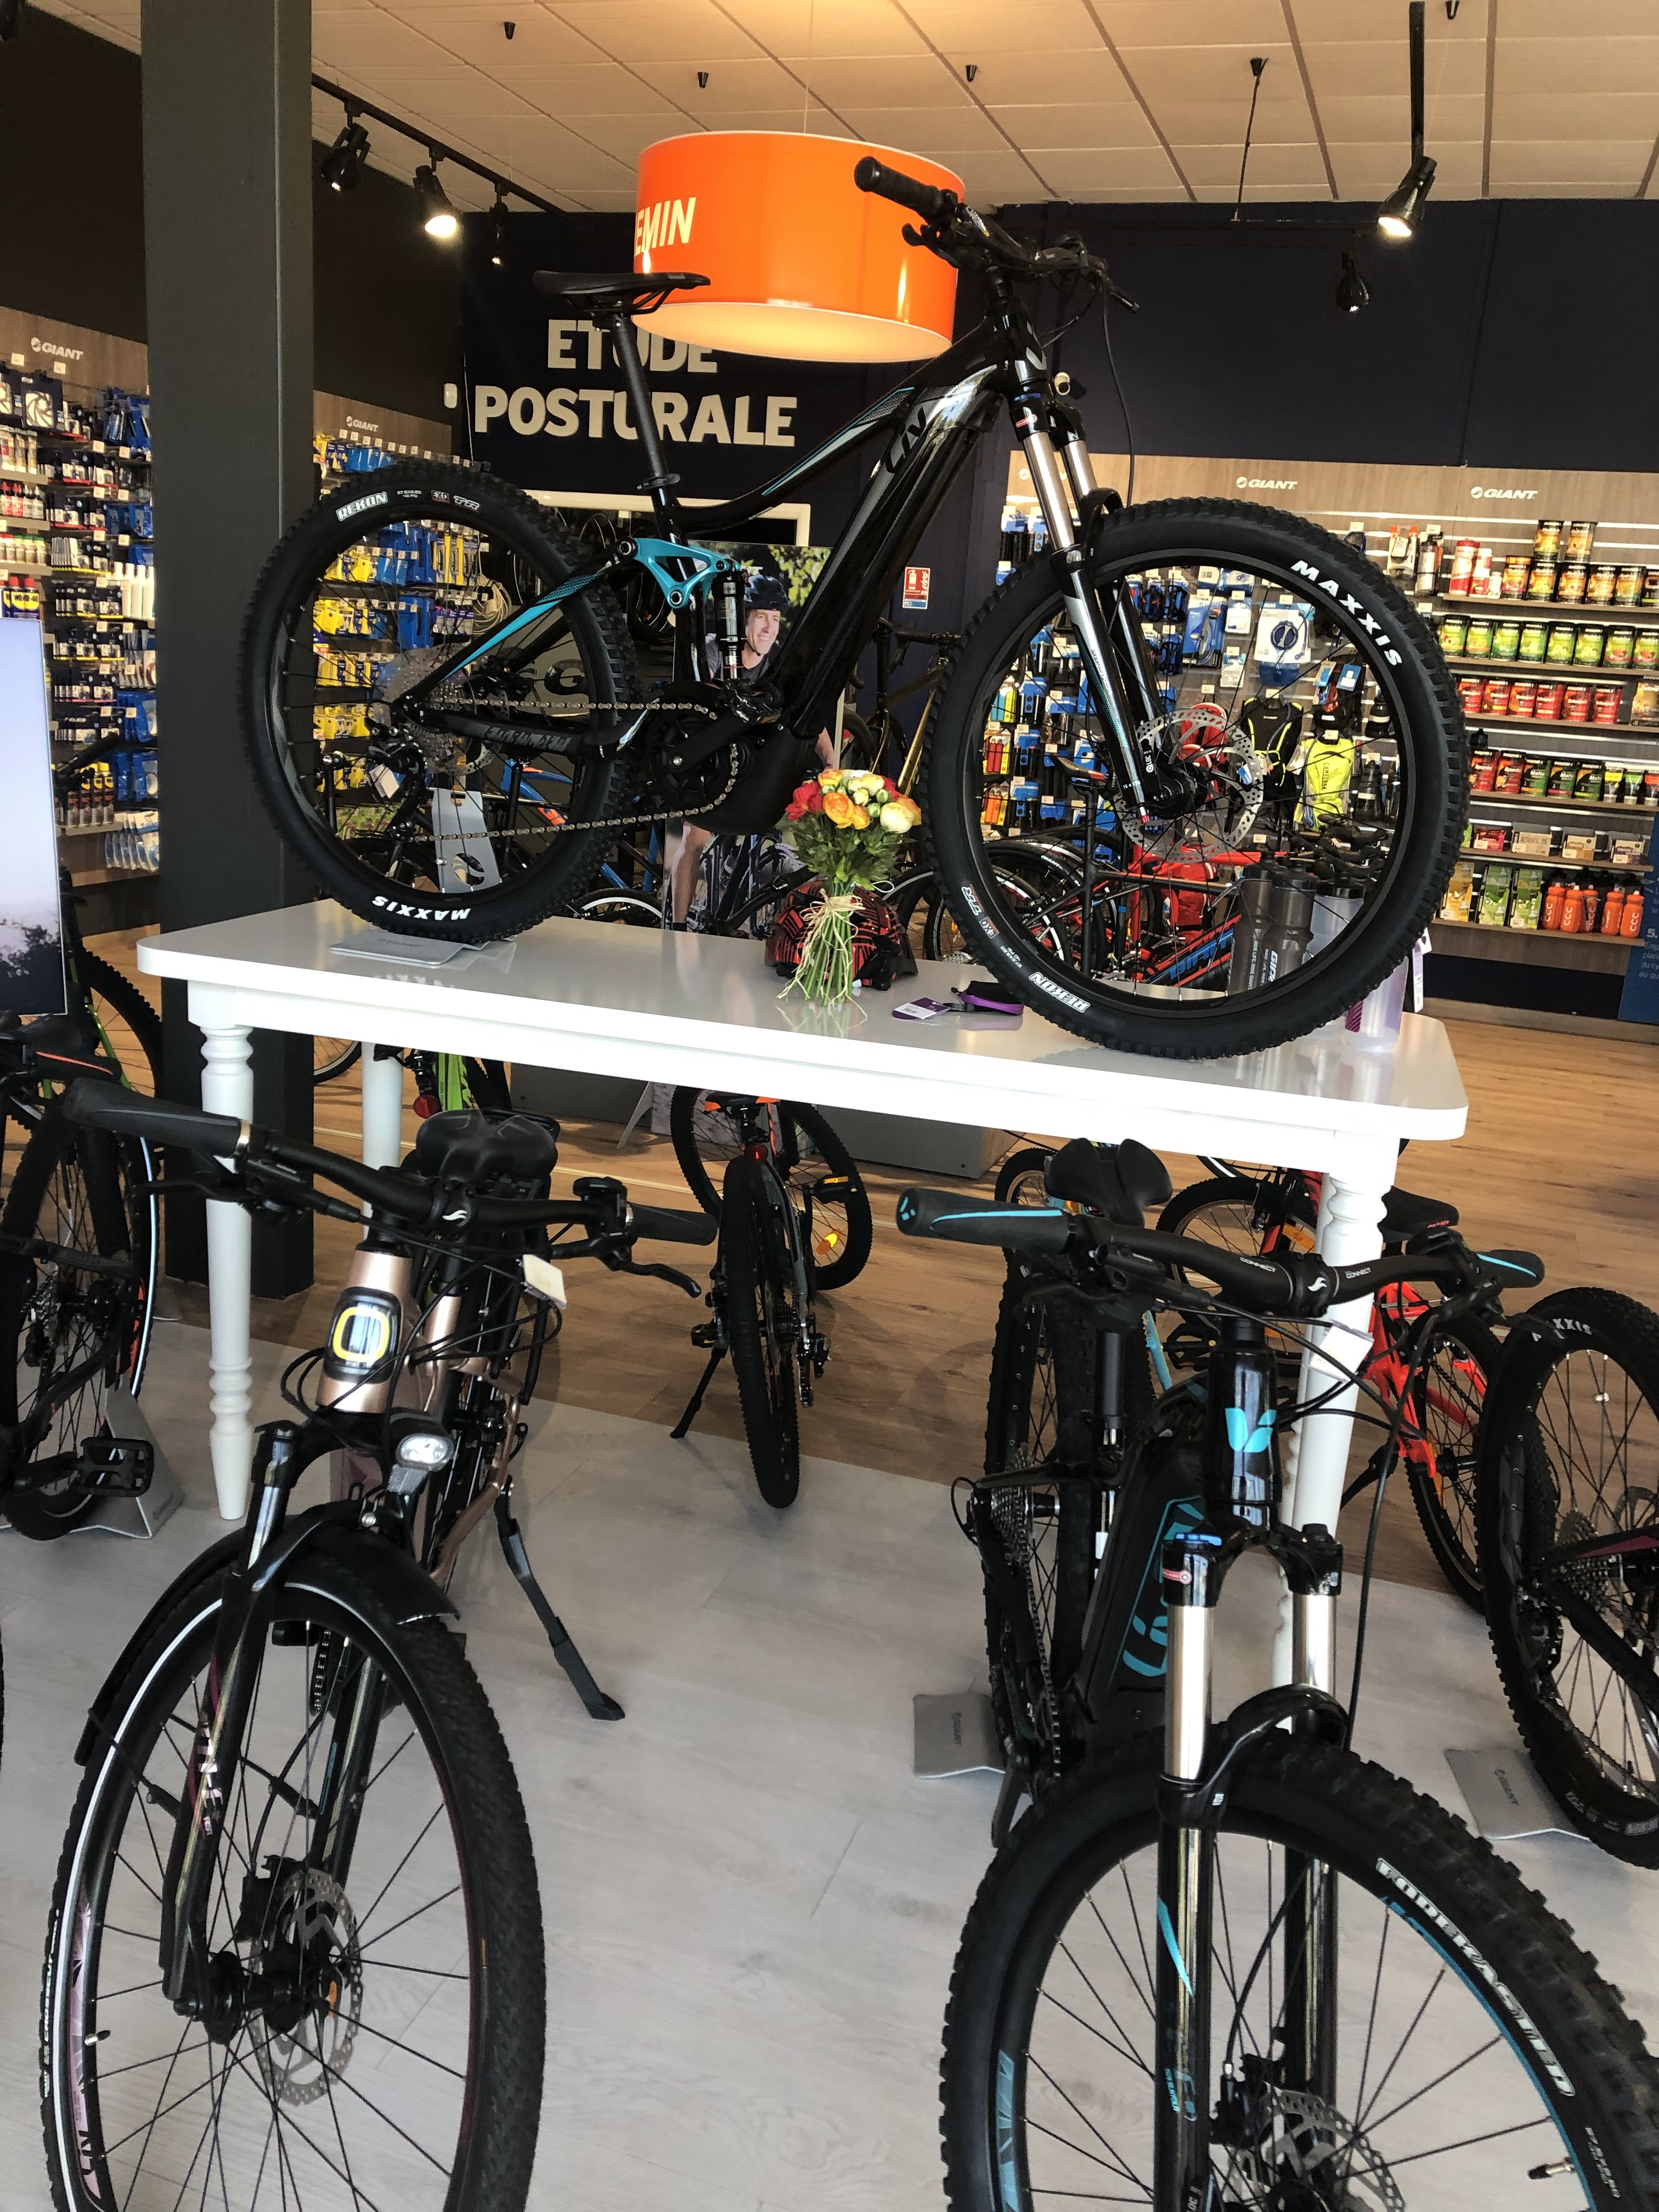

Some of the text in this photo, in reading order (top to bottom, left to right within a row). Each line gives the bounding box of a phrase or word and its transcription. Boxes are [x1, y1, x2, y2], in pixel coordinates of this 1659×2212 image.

[42, 341, 83, 360] GIANT
[352, 418, 379, 432] GIANT
[475, 385, 797, 447] POSTURALE
[1248, 479, 1298, 490] GIANT
[1483, 488, 1538, 500] GIANT
[335, 491, 388, 522] REKON
[1291, 560, 1402, 667] MAXXIS
[371, 896, 472, 921] MAXXIS
[1544, 902, 1553, 922] CCC
[1564, 907, 1573, 926] CCC
[1629, 912, 1640, 932] CCC
[1170, 928, 1234, 980] GIANT
[1028, 971, 1091, 1013] REKON
[1239, 1256, 1277, 1273] CONNECT
[1346, 1267, 1372, 1279] CONNECT
